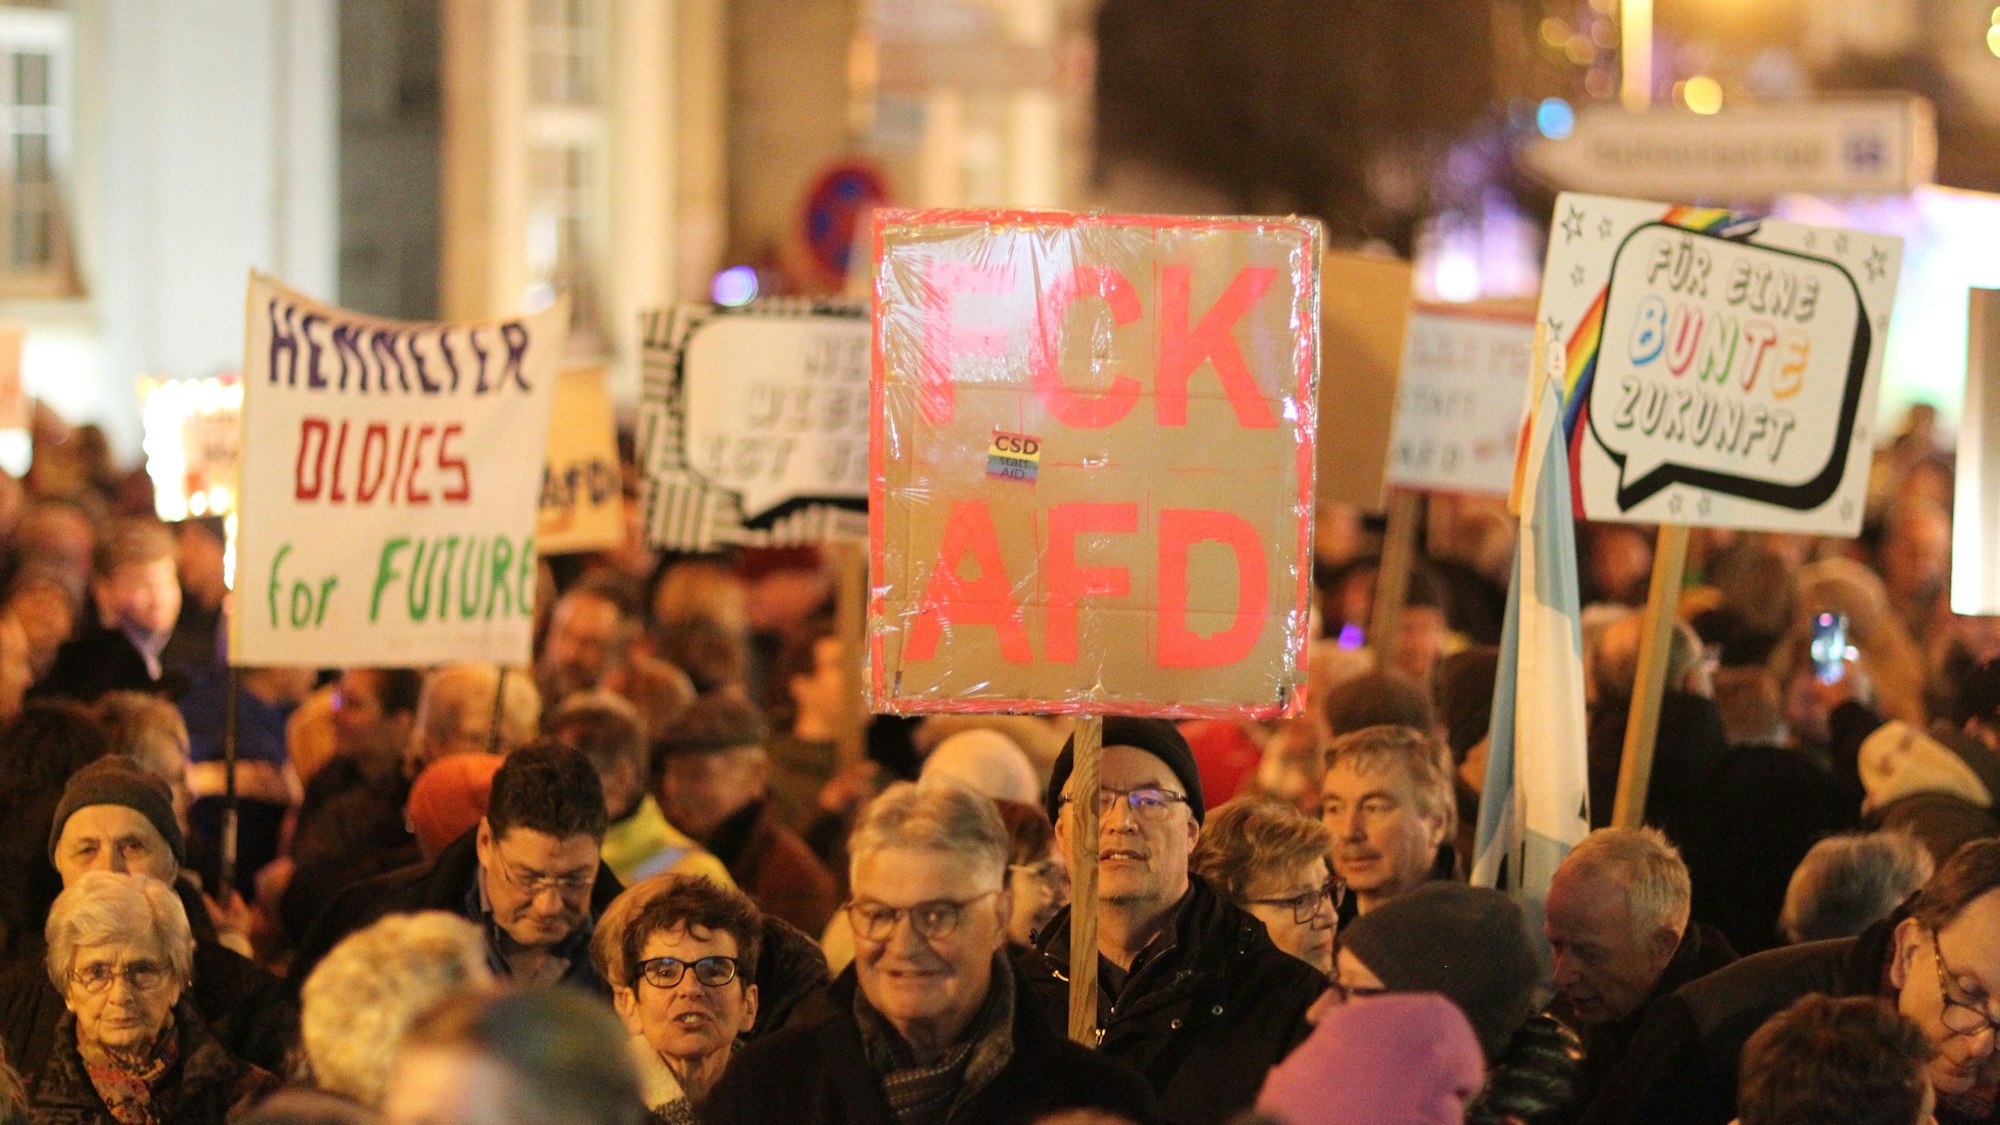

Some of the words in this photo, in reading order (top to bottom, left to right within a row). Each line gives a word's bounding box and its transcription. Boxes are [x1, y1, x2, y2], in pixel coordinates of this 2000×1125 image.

[1648, 232, 1713, 298] FÜR
[1726, 256, 1820, 322] EINE
[269, 299, 531, 394] HENNEFER
[921, 262, 1279, 429] FCK
[1628, 293, 1811, 400] BUNTE
[295, 416, 470, 504] OLDIES
[995, 435, 1039, 455] CSD
[1615, 373, 1796, 464] ZUKUNFT
[267, 542, 338, 629] for
[904, 499, 1268, 668] AFD
